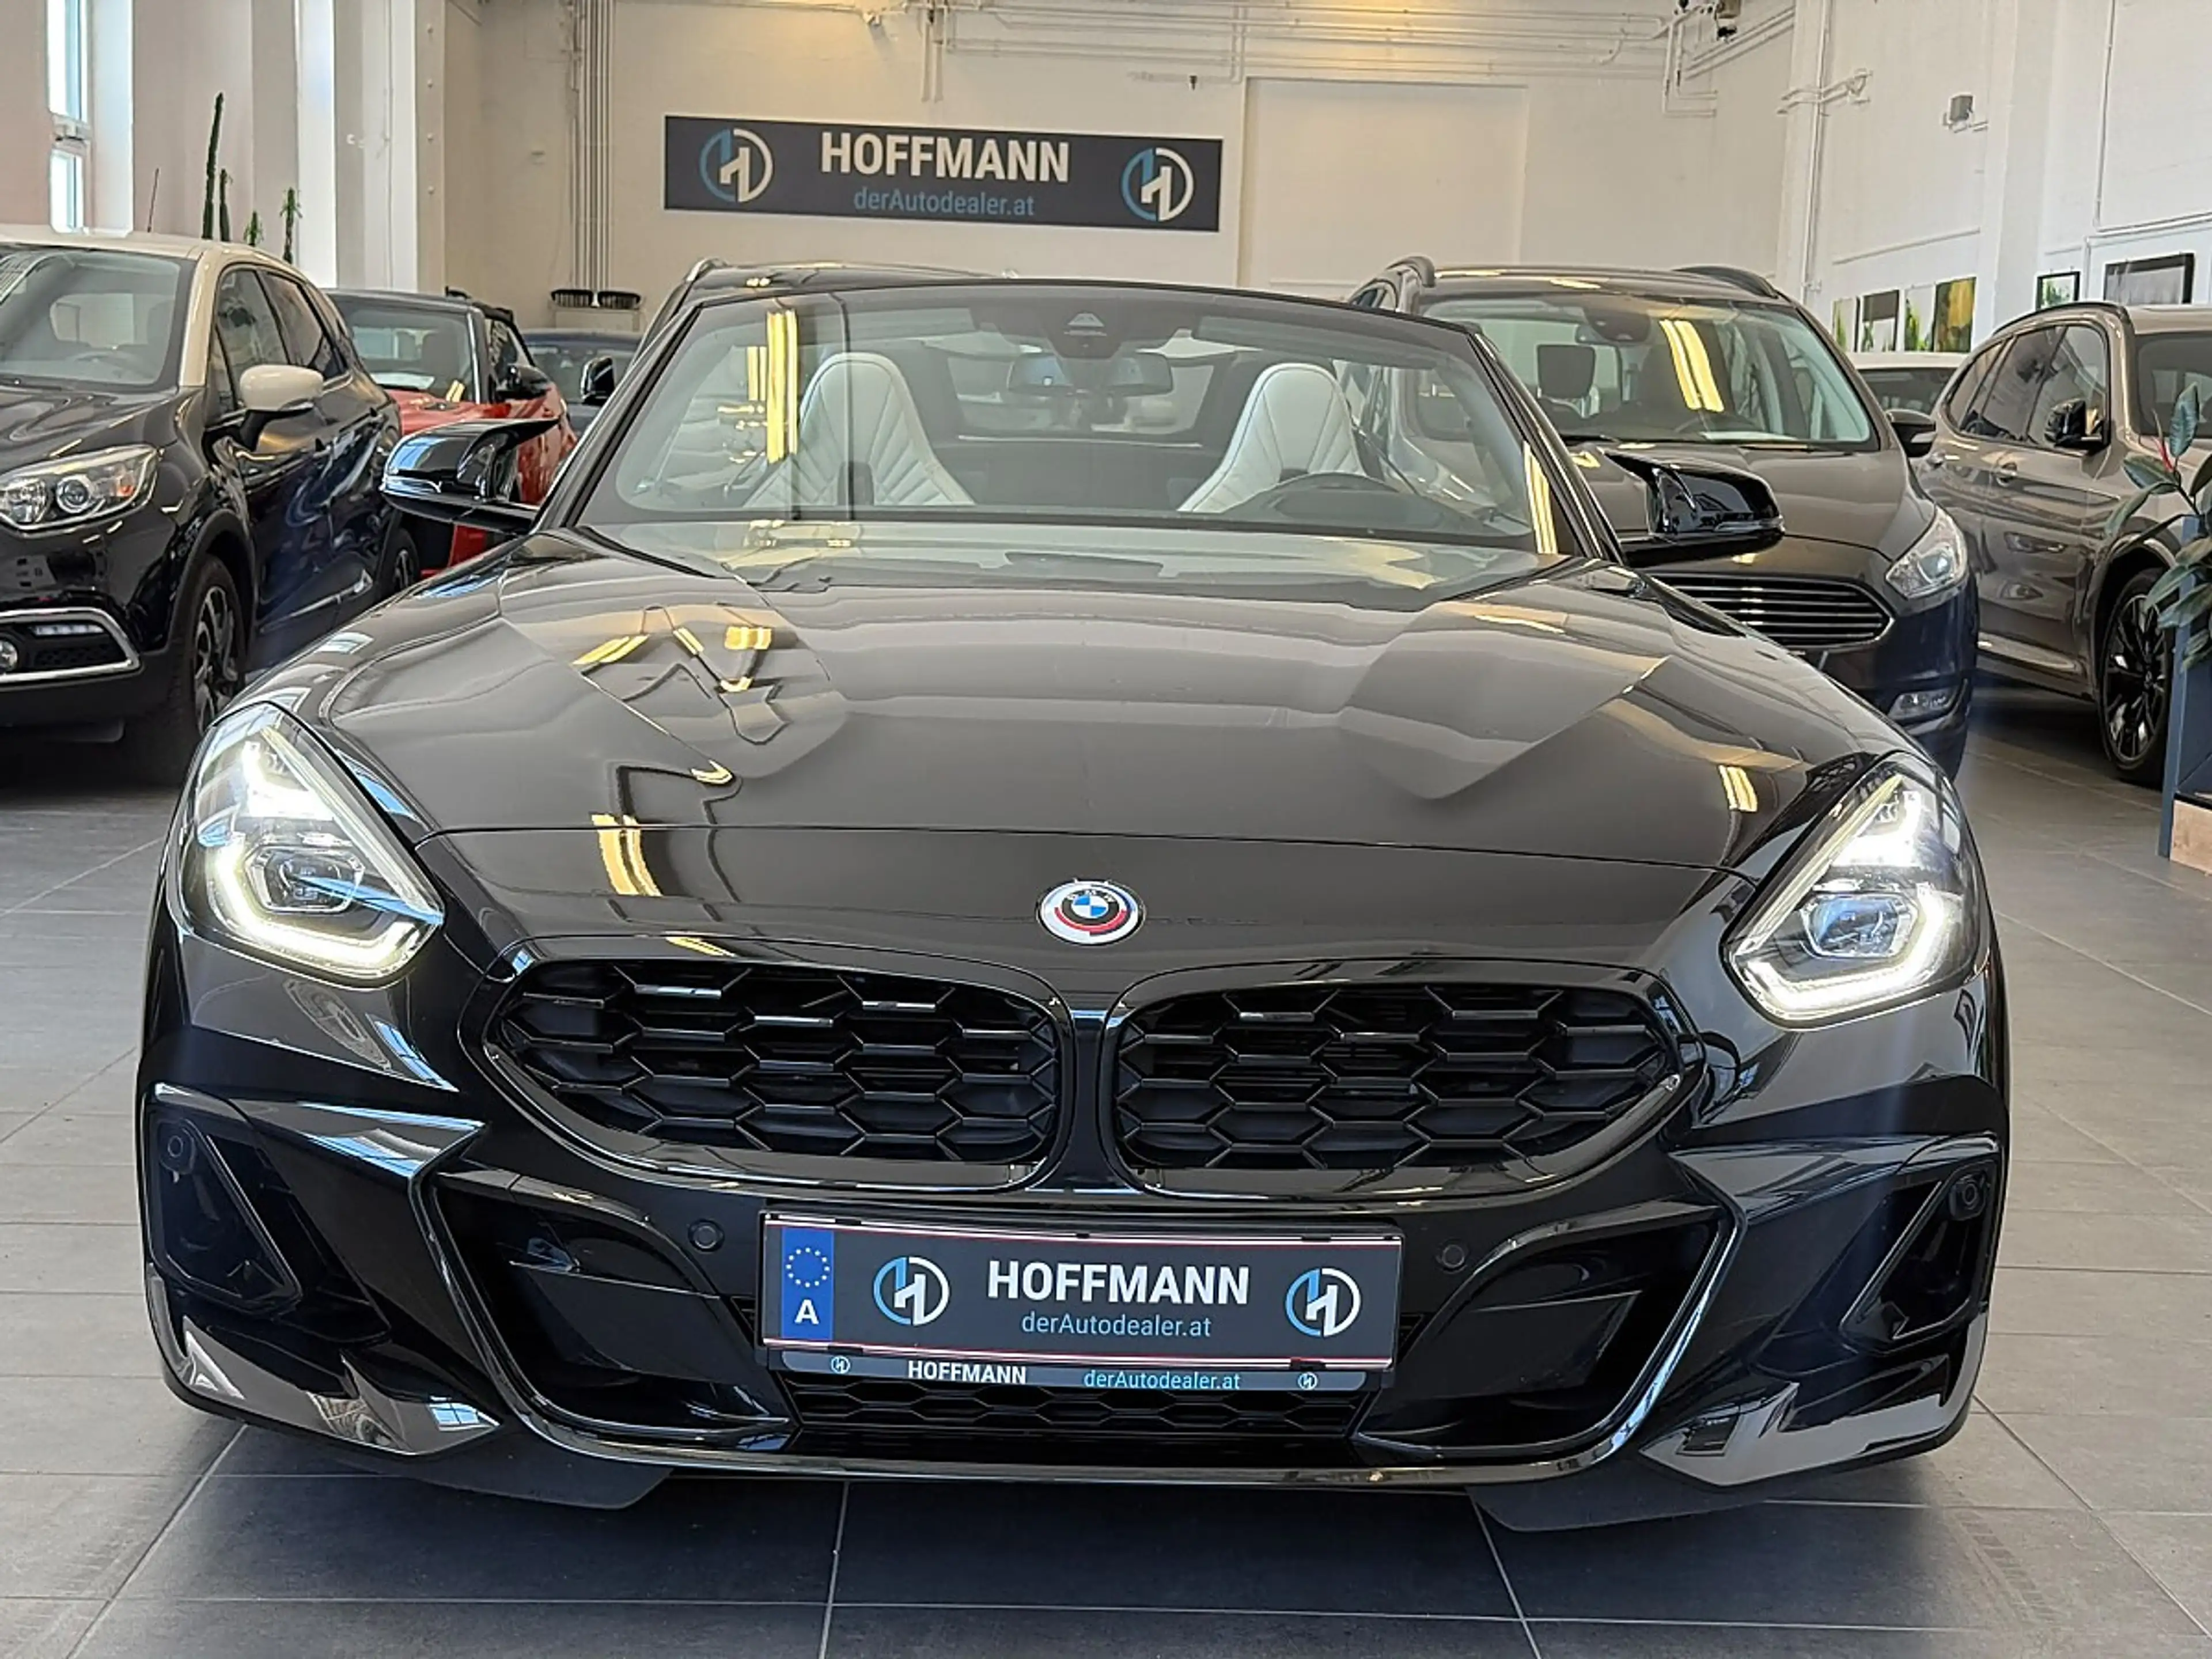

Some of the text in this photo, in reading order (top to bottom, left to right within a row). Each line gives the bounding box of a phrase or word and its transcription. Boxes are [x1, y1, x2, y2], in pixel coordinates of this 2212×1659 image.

[821, 131, 1069, 182] HOFFMANN
[854, 186, 1035, 217] derAutodealer.at
[987, 1260, 1250, 1305] HOFFMANN
[794, 1297, 820, 1325] A
[1022, 1310, 1212, 1337] derAutodealer.at
[907, 1359, 1241, 1391] HOFFMANN derAutodealer.at
